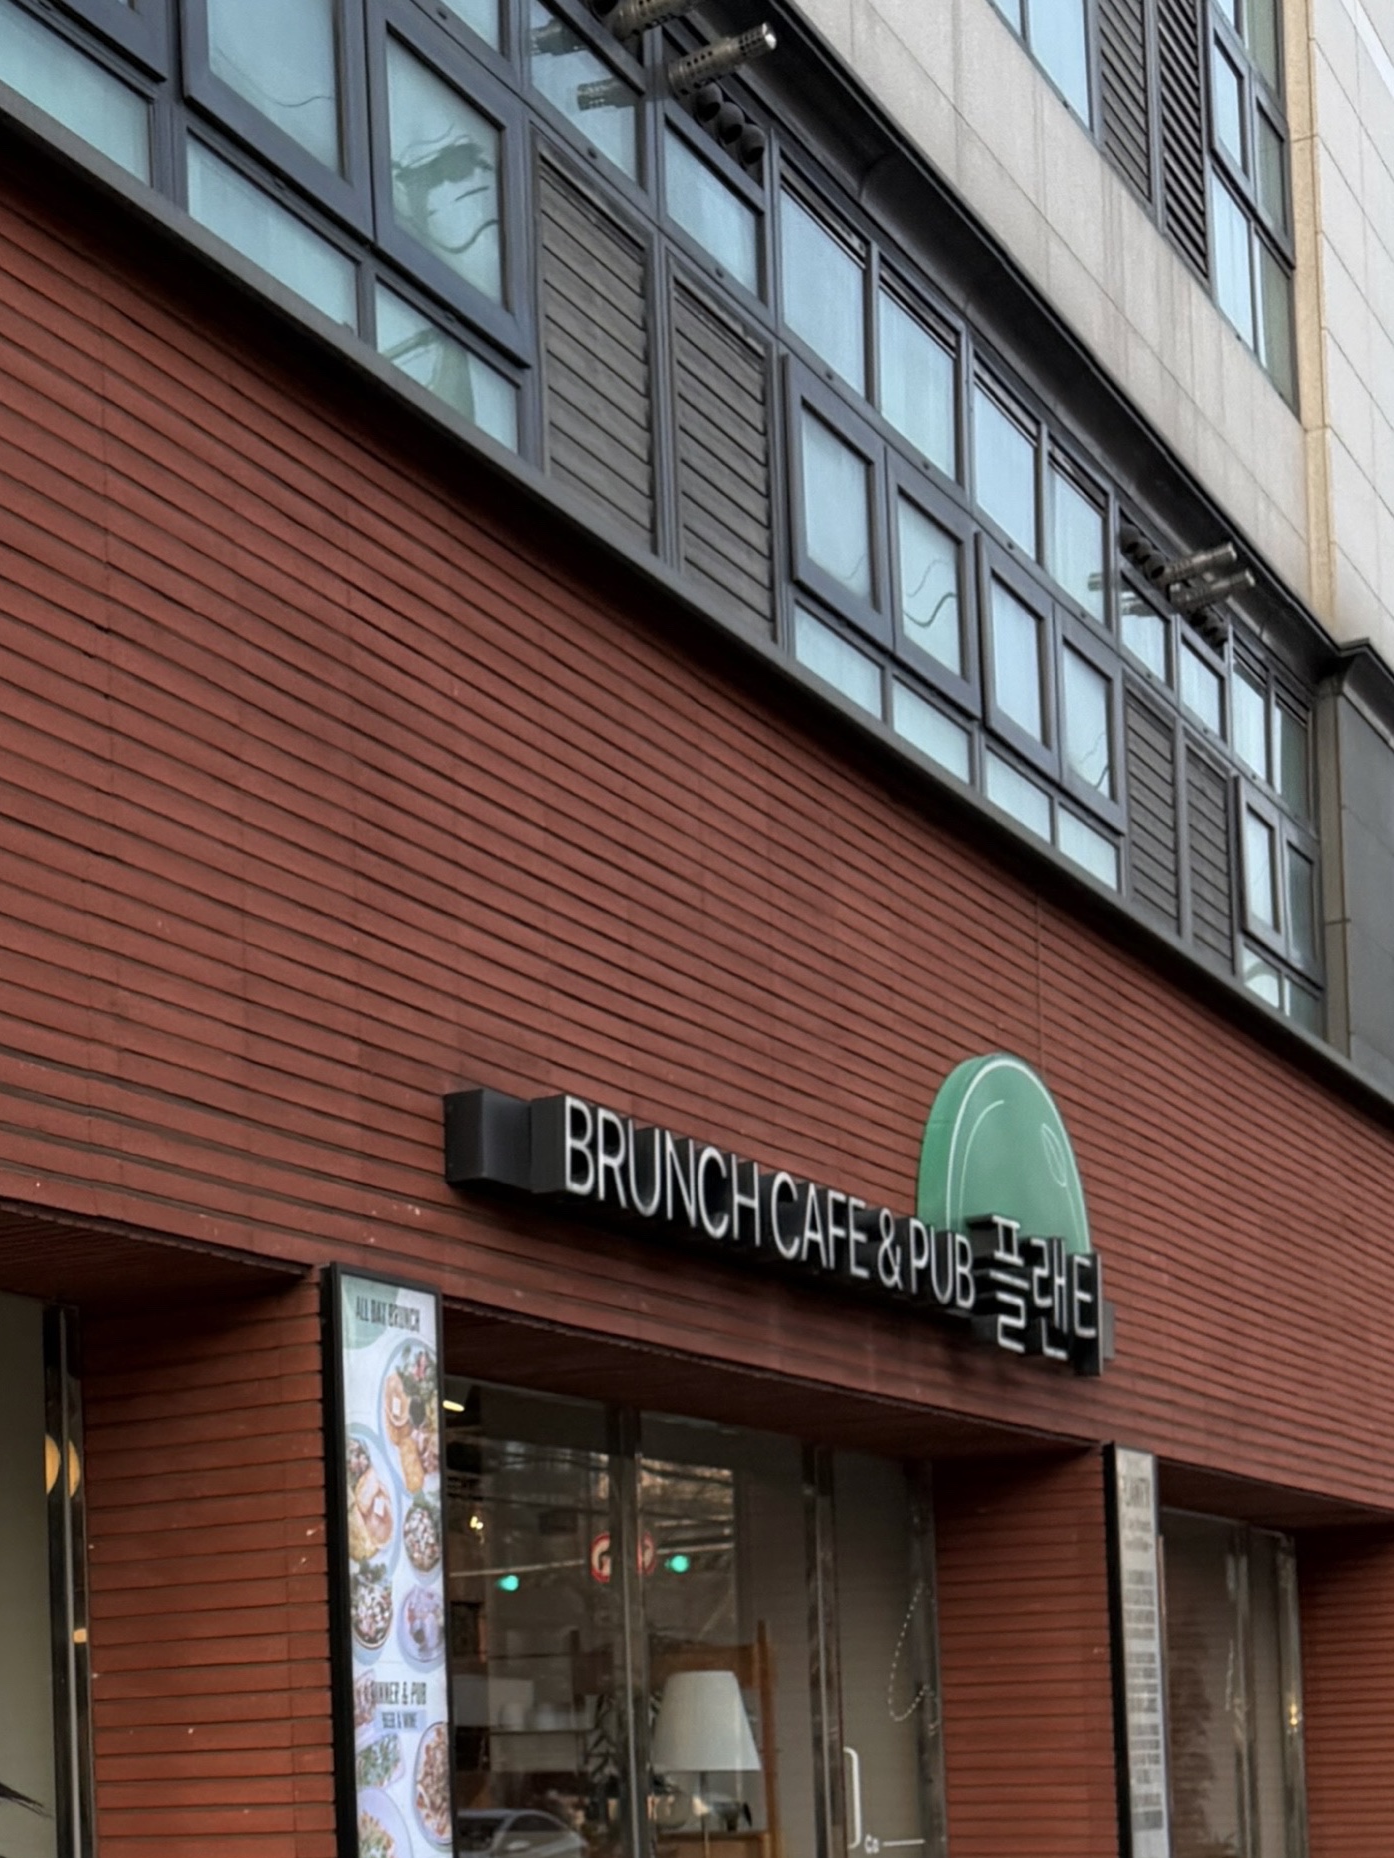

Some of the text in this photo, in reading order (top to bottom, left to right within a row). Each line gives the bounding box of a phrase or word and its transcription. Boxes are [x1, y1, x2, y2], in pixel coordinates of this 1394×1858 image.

[565, 1095, 977, 1310] BRUNCH CAFE & PUB
